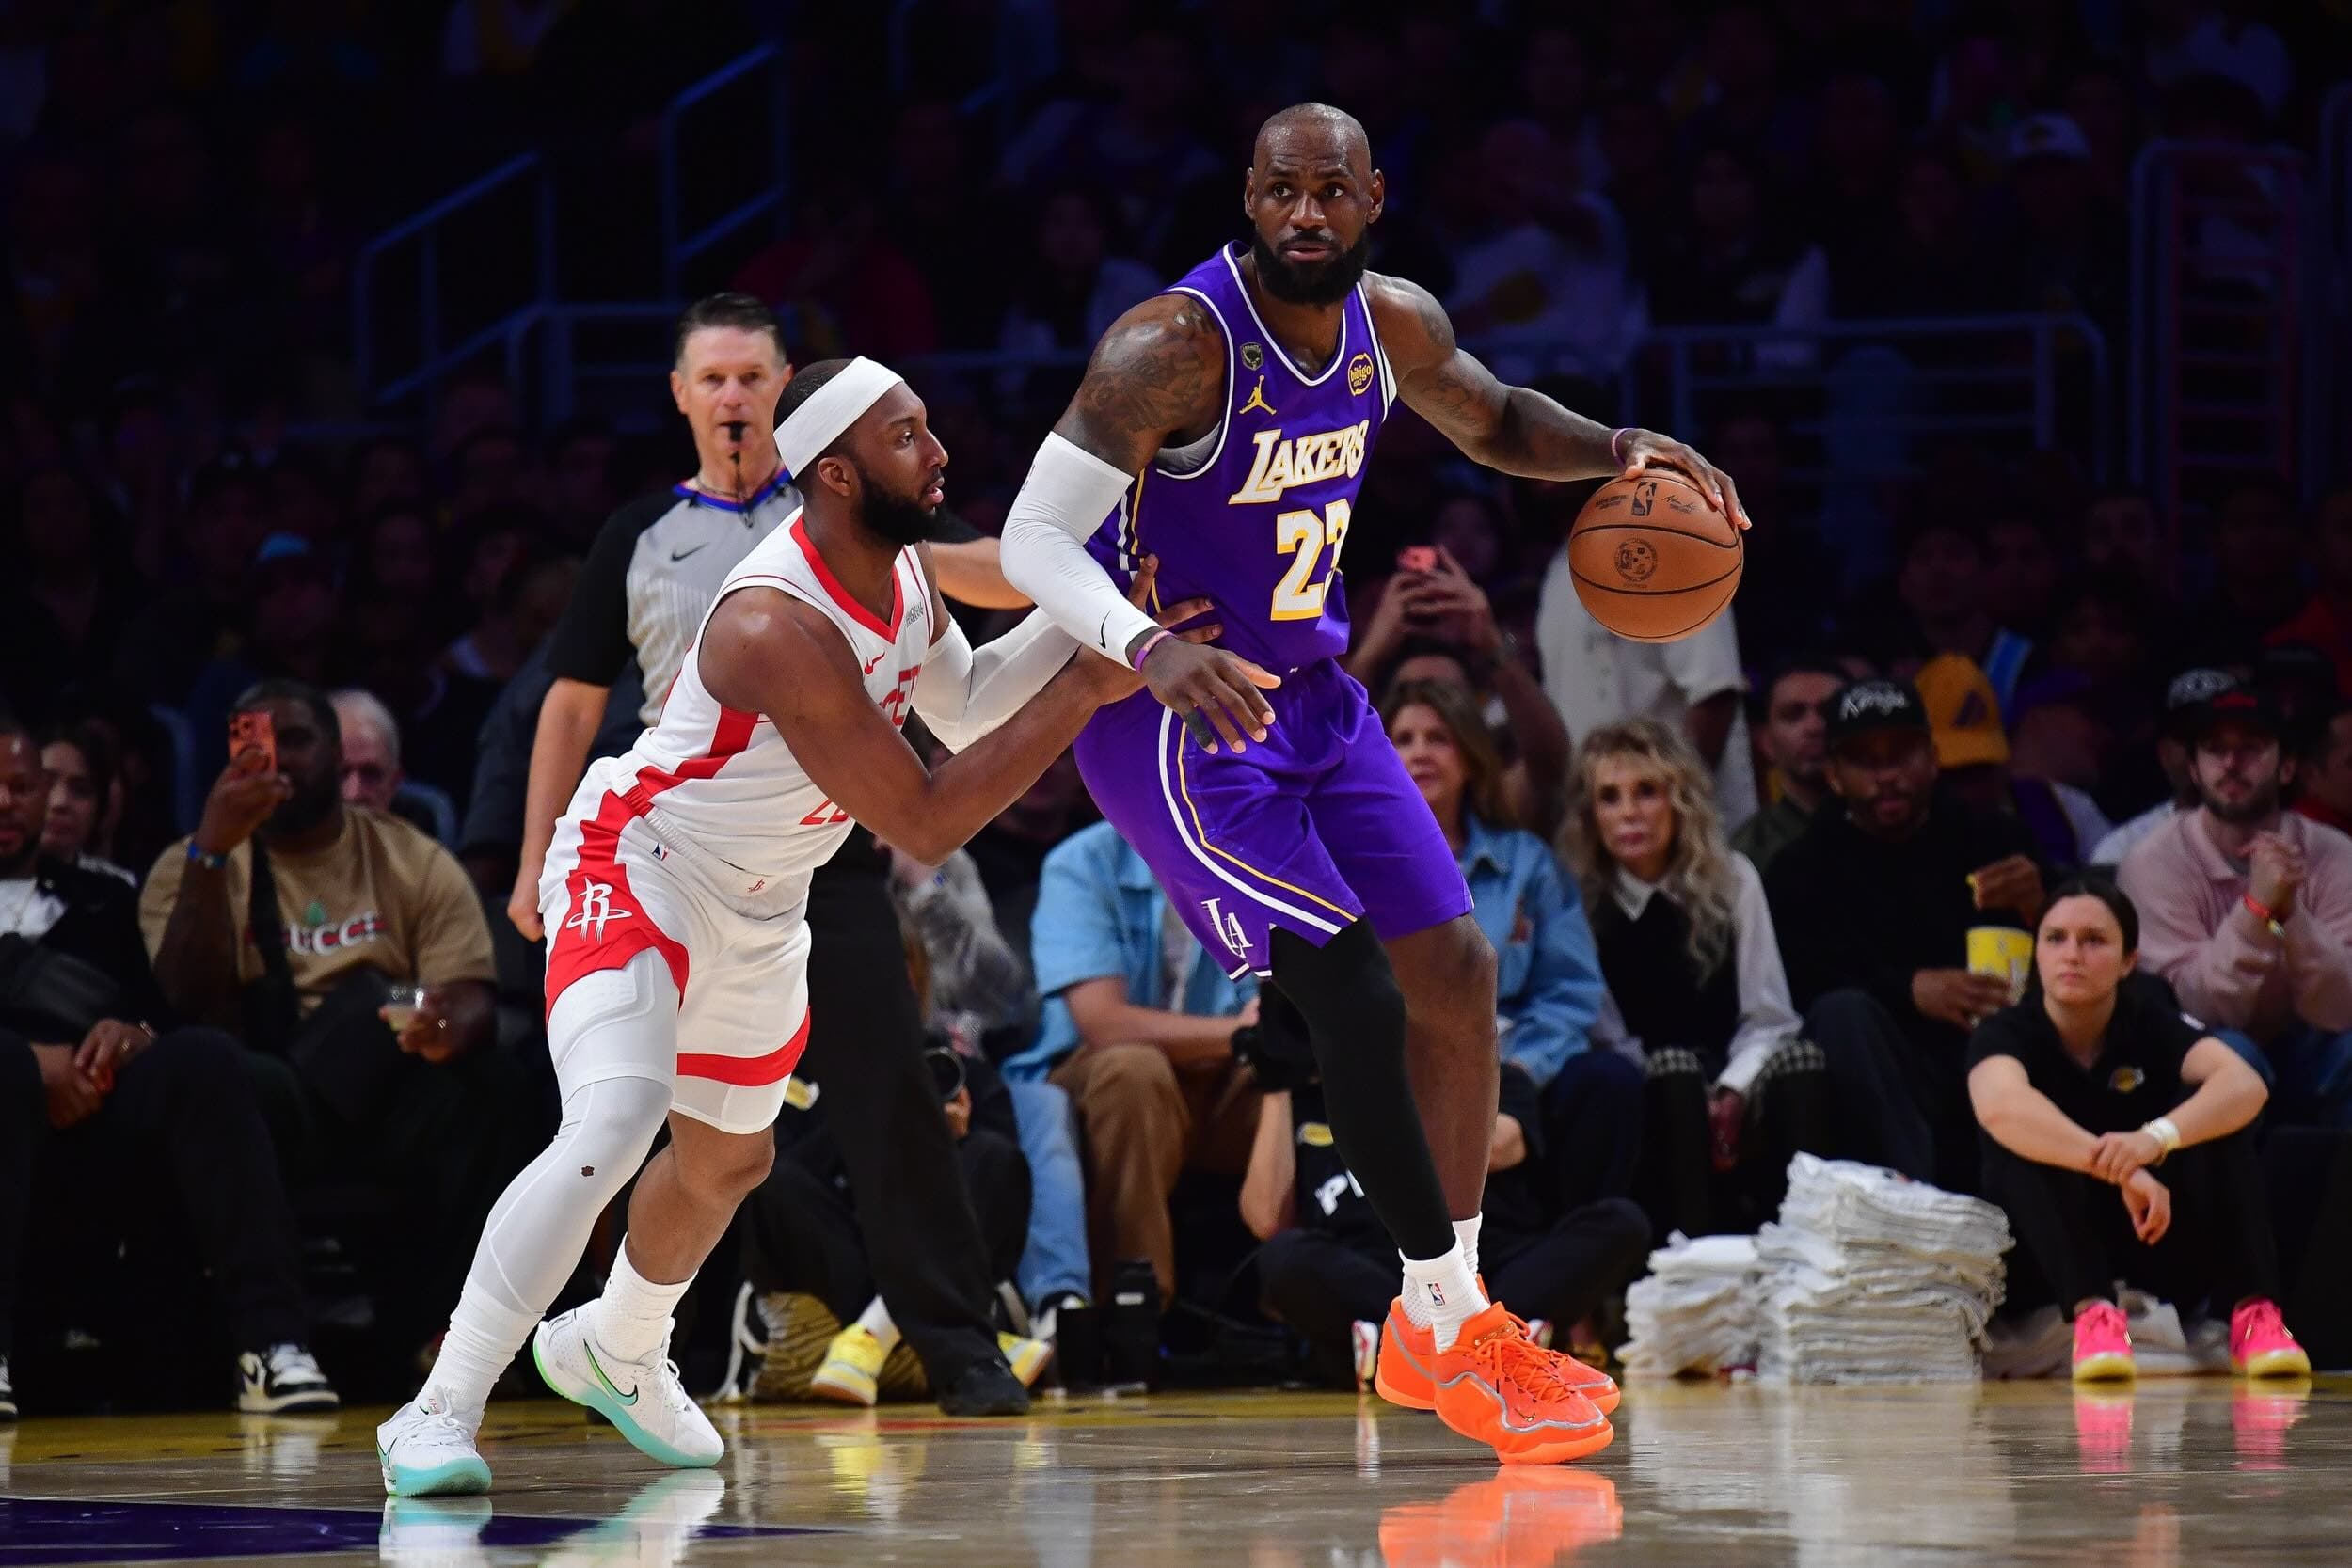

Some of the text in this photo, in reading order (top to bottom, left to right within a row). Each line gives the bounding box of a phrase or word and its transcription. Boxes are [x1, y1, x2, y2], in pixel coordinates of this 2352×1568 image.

[1350, 364, 1372, 382] bibigo
[1228, 420, 1370, 504] LAKERS
[288, 911, 378, 957] UCCI
[1200, 897, 1254, 959] LA
